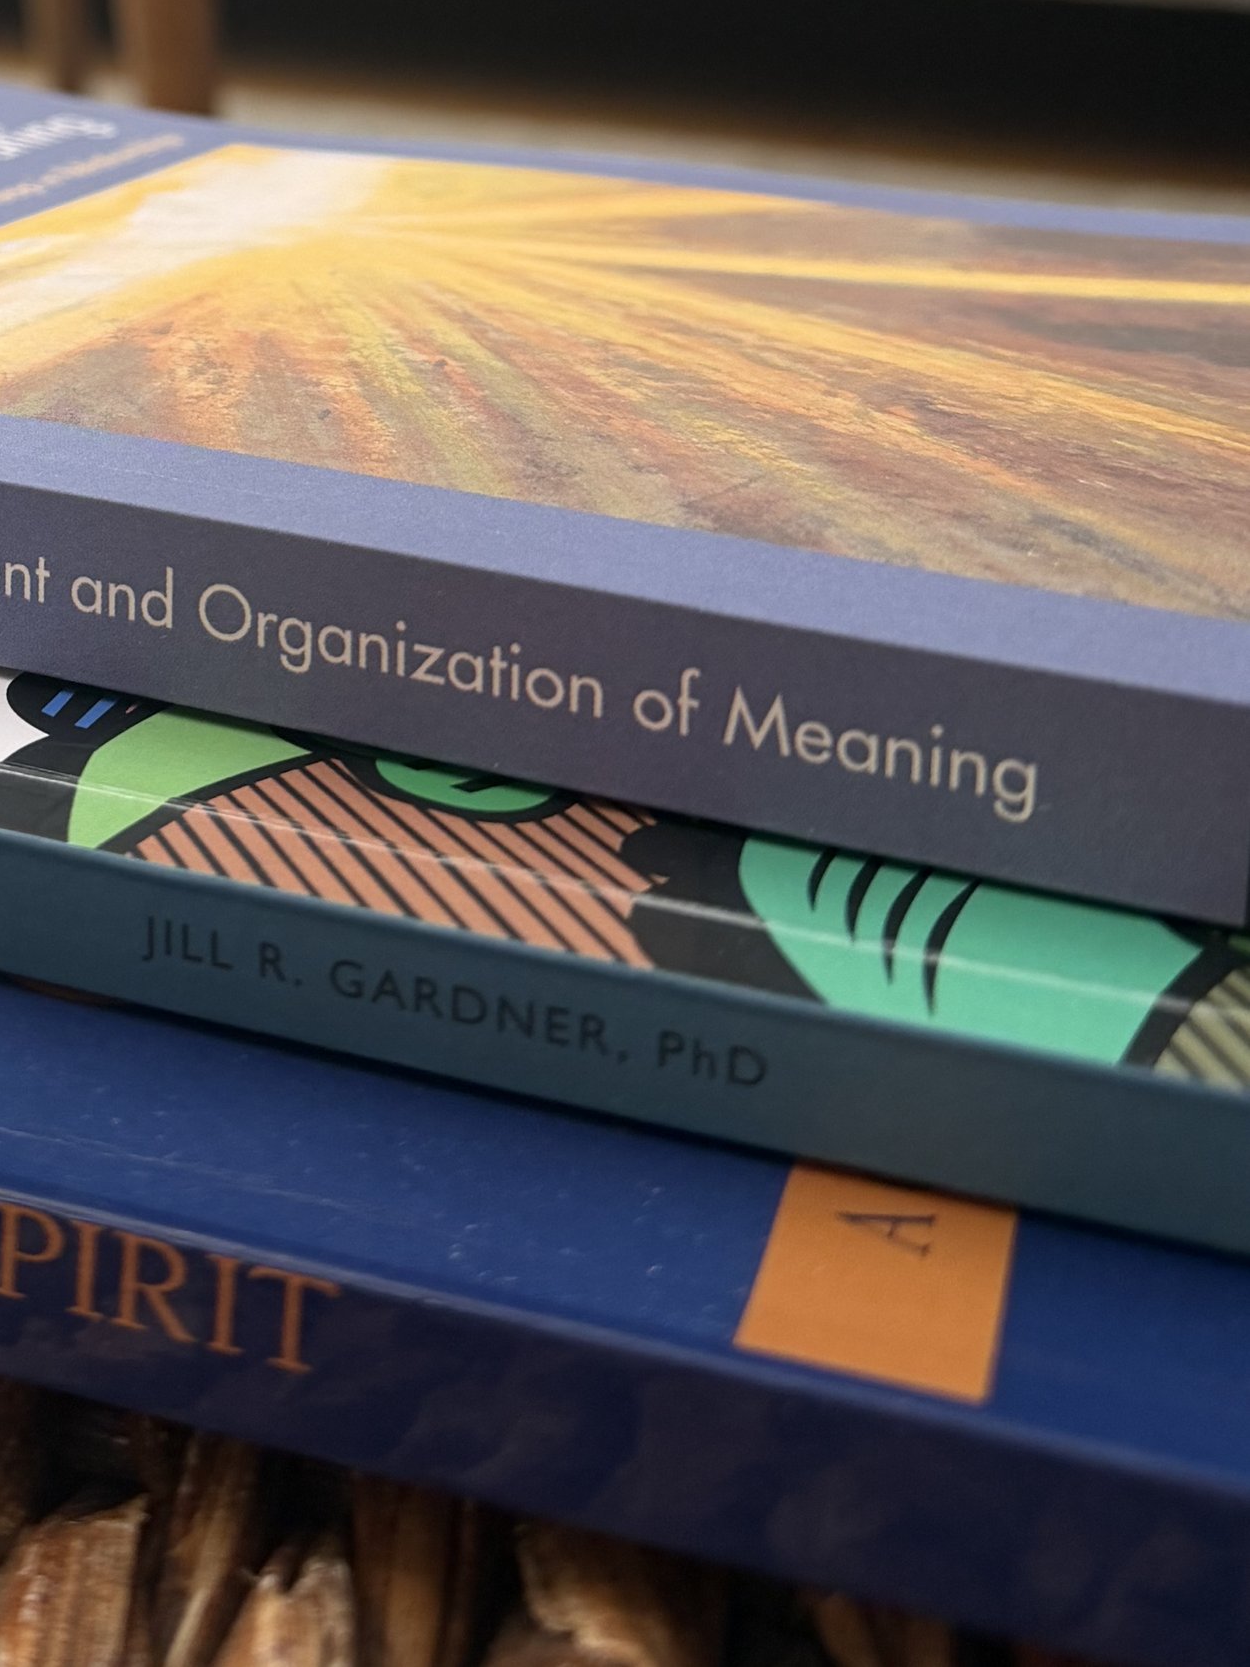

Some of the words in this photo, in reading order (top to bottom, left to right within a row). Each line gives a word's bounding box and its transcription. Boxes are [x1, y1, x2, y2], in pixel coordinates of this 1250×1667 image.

[70, 567, 174, 629] and
[198, 582, 604, 719] Organization
[633, 667, 702, 737] of
[723, 686, 1040, 824] Meaning
[142, 915, 234, 971] JILL
[258, 941, 303, 989] R.
[329, 959, 629, 1065] GARDNER,
[657, 1030, 767, 1087] PhD
